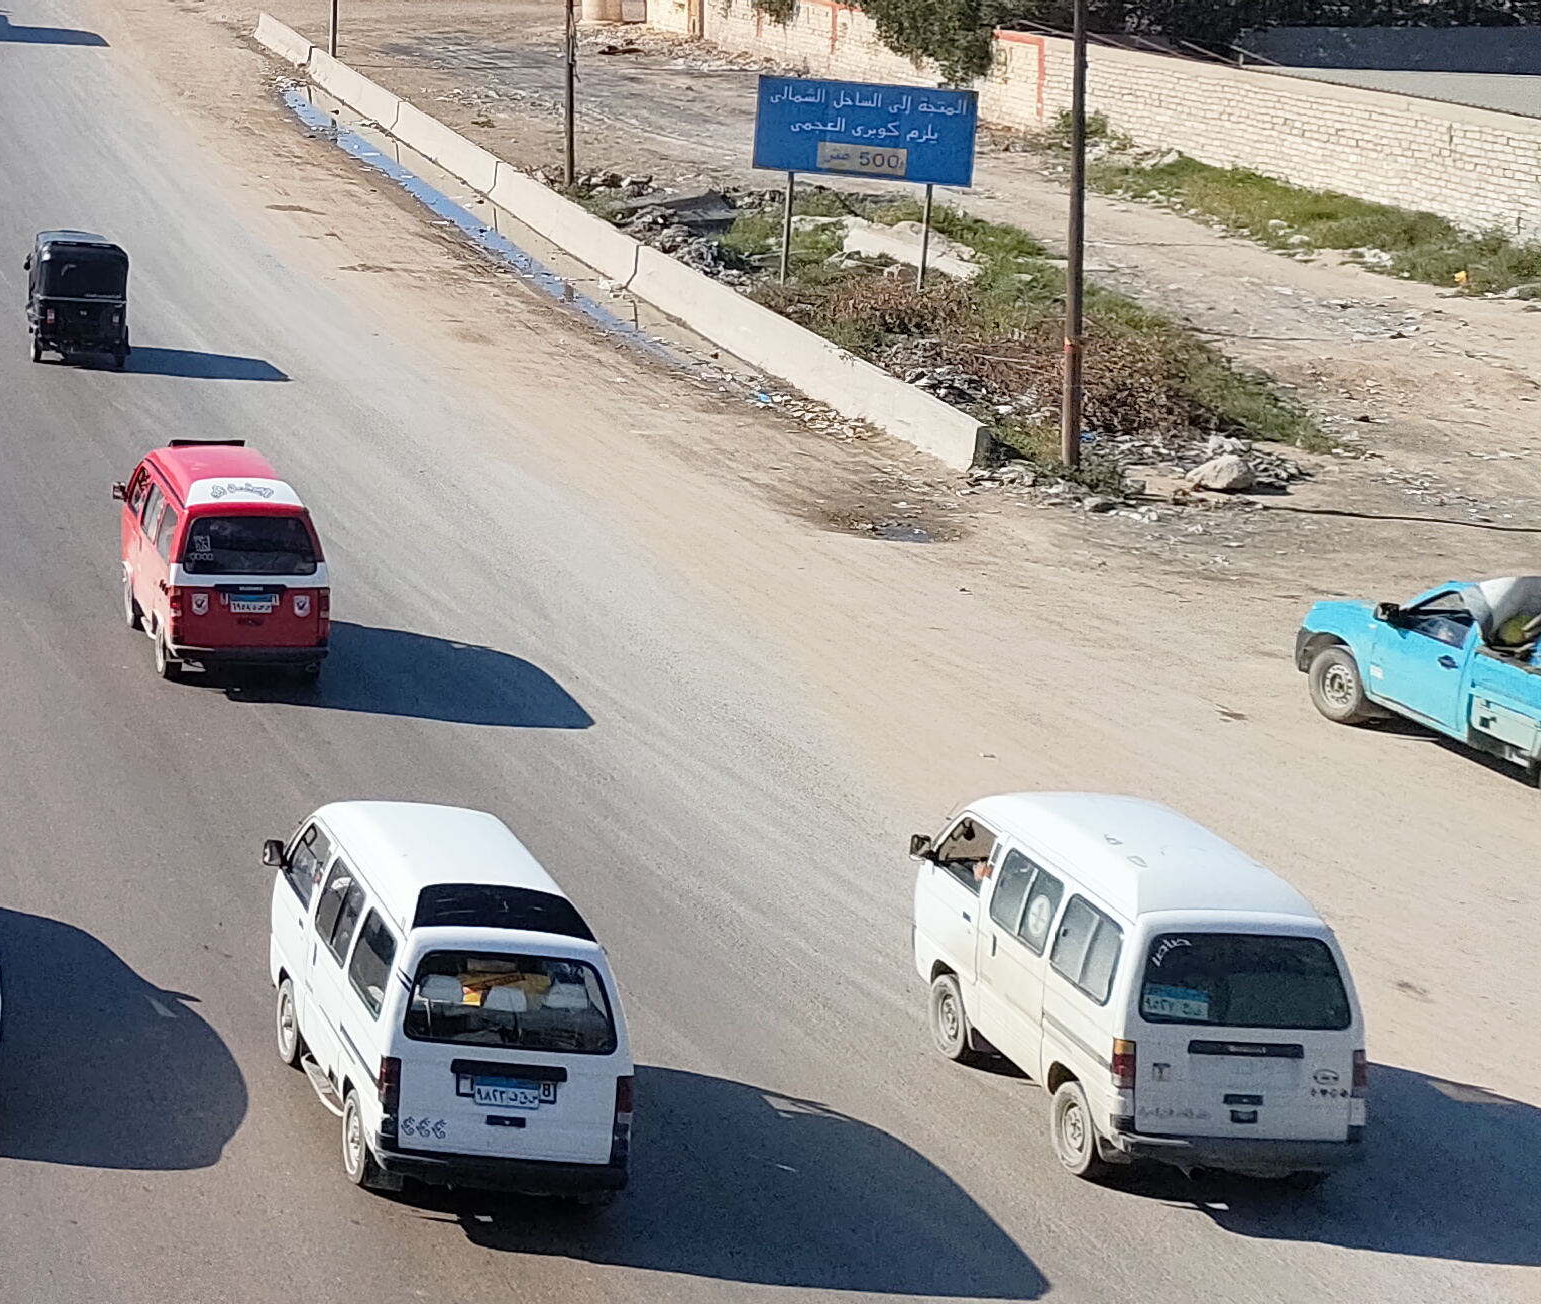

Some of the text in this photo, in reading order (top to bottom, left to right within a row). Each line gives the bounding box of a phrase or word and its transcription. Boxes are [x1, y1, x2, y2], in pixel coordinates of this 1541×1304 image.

[833, 89, 882, 109] الساحل
[906, 123, 938, 143] يلزم
[859, 151, 899, 169] 500
